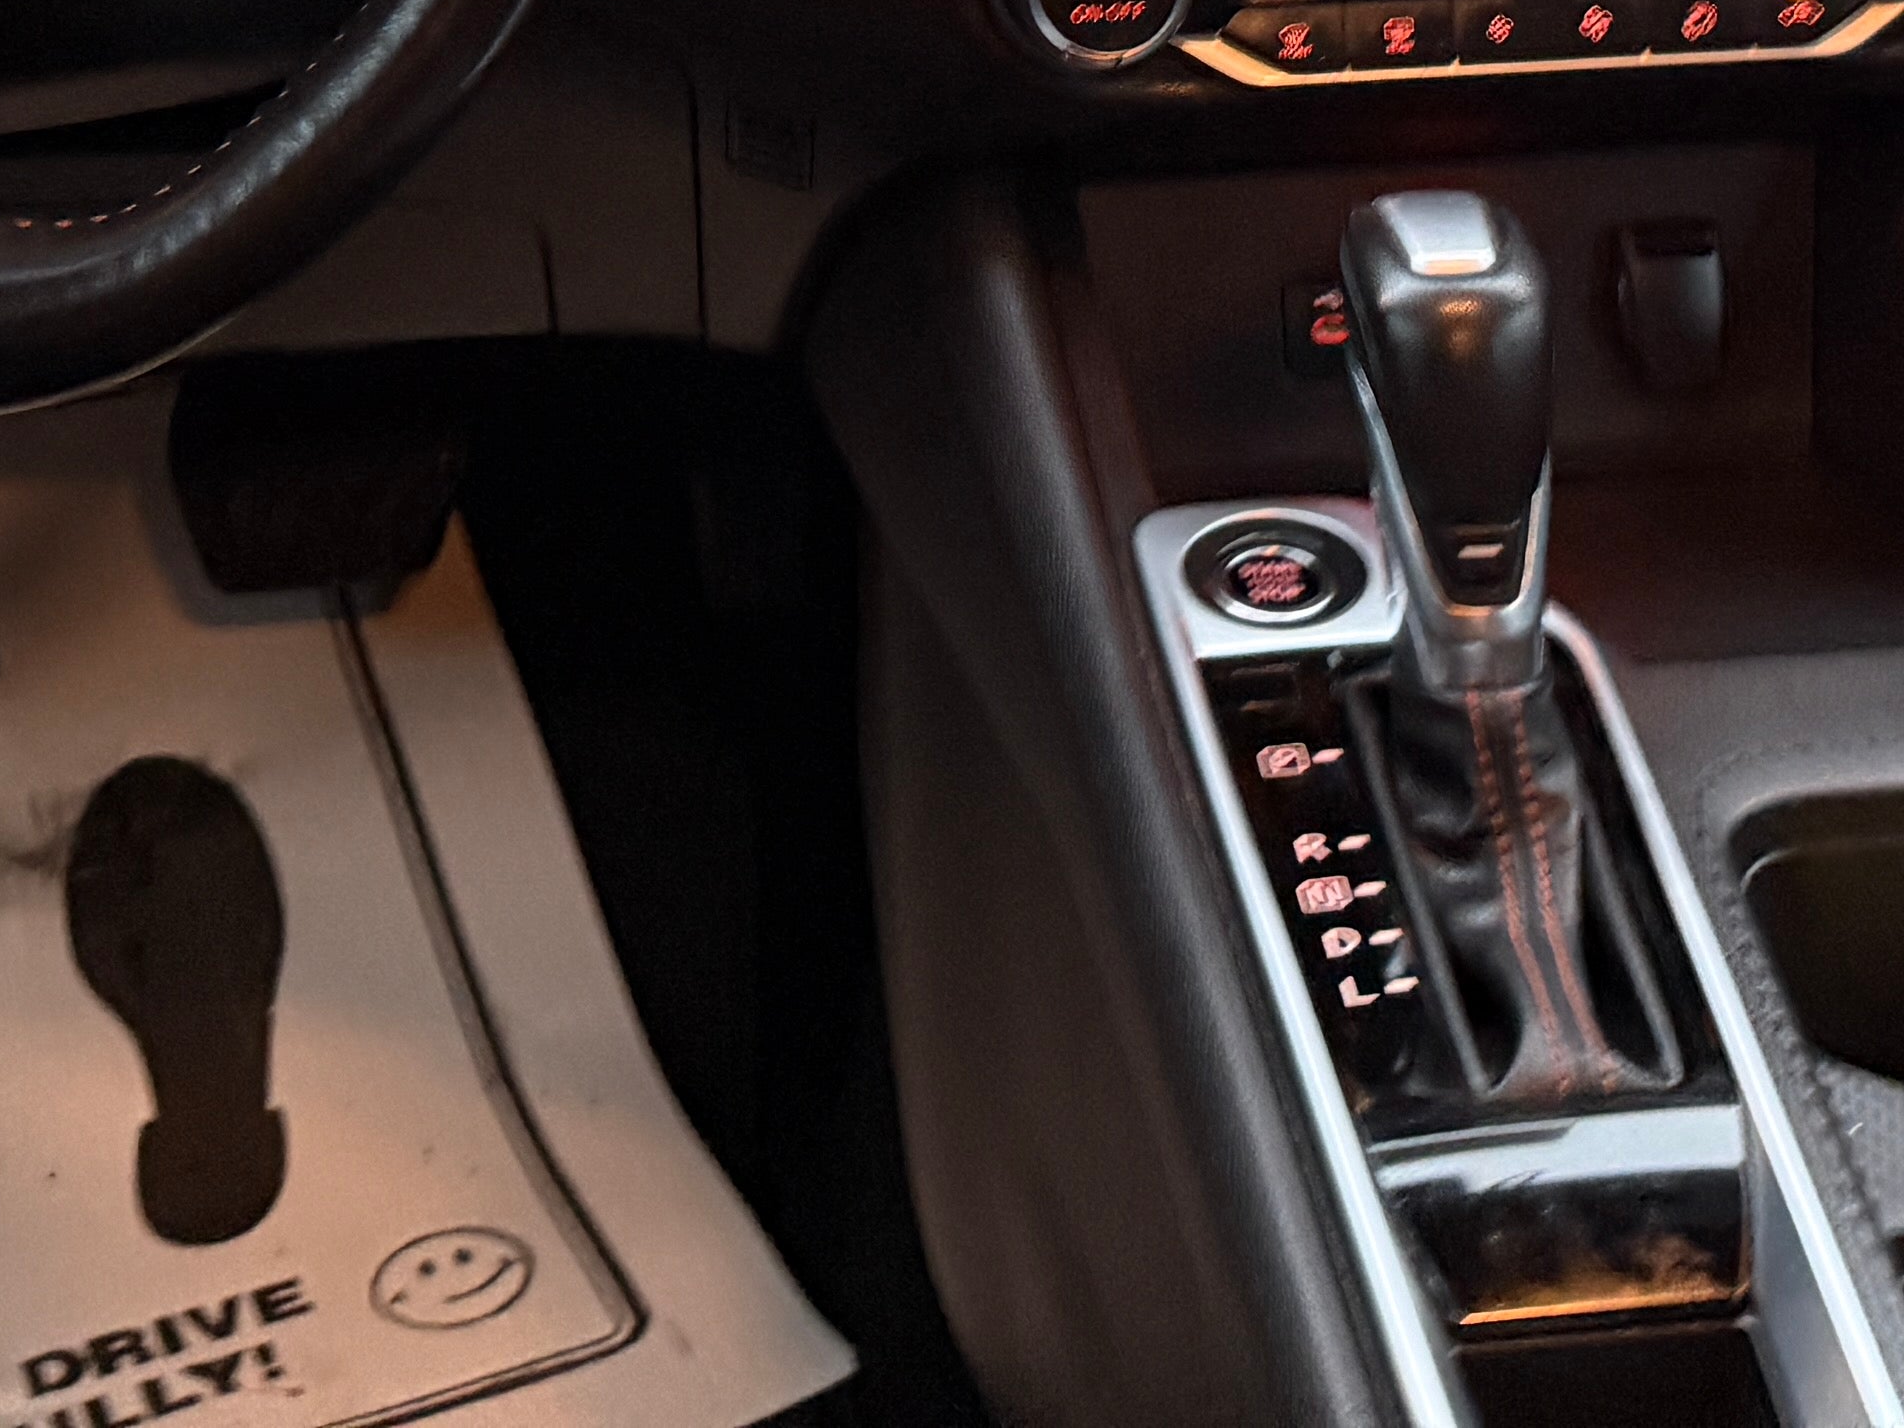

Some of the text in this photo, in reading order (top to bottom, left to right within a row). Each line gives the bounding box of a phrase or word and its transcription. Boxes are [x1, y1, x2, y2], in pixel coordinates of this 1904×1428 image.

[1293, 832, 1333, 864] R
[1321, 926, 1362, 959] D
[1338, 975, 1381, 1008] L
[18, 1277, 315, 1400] DRIVE
